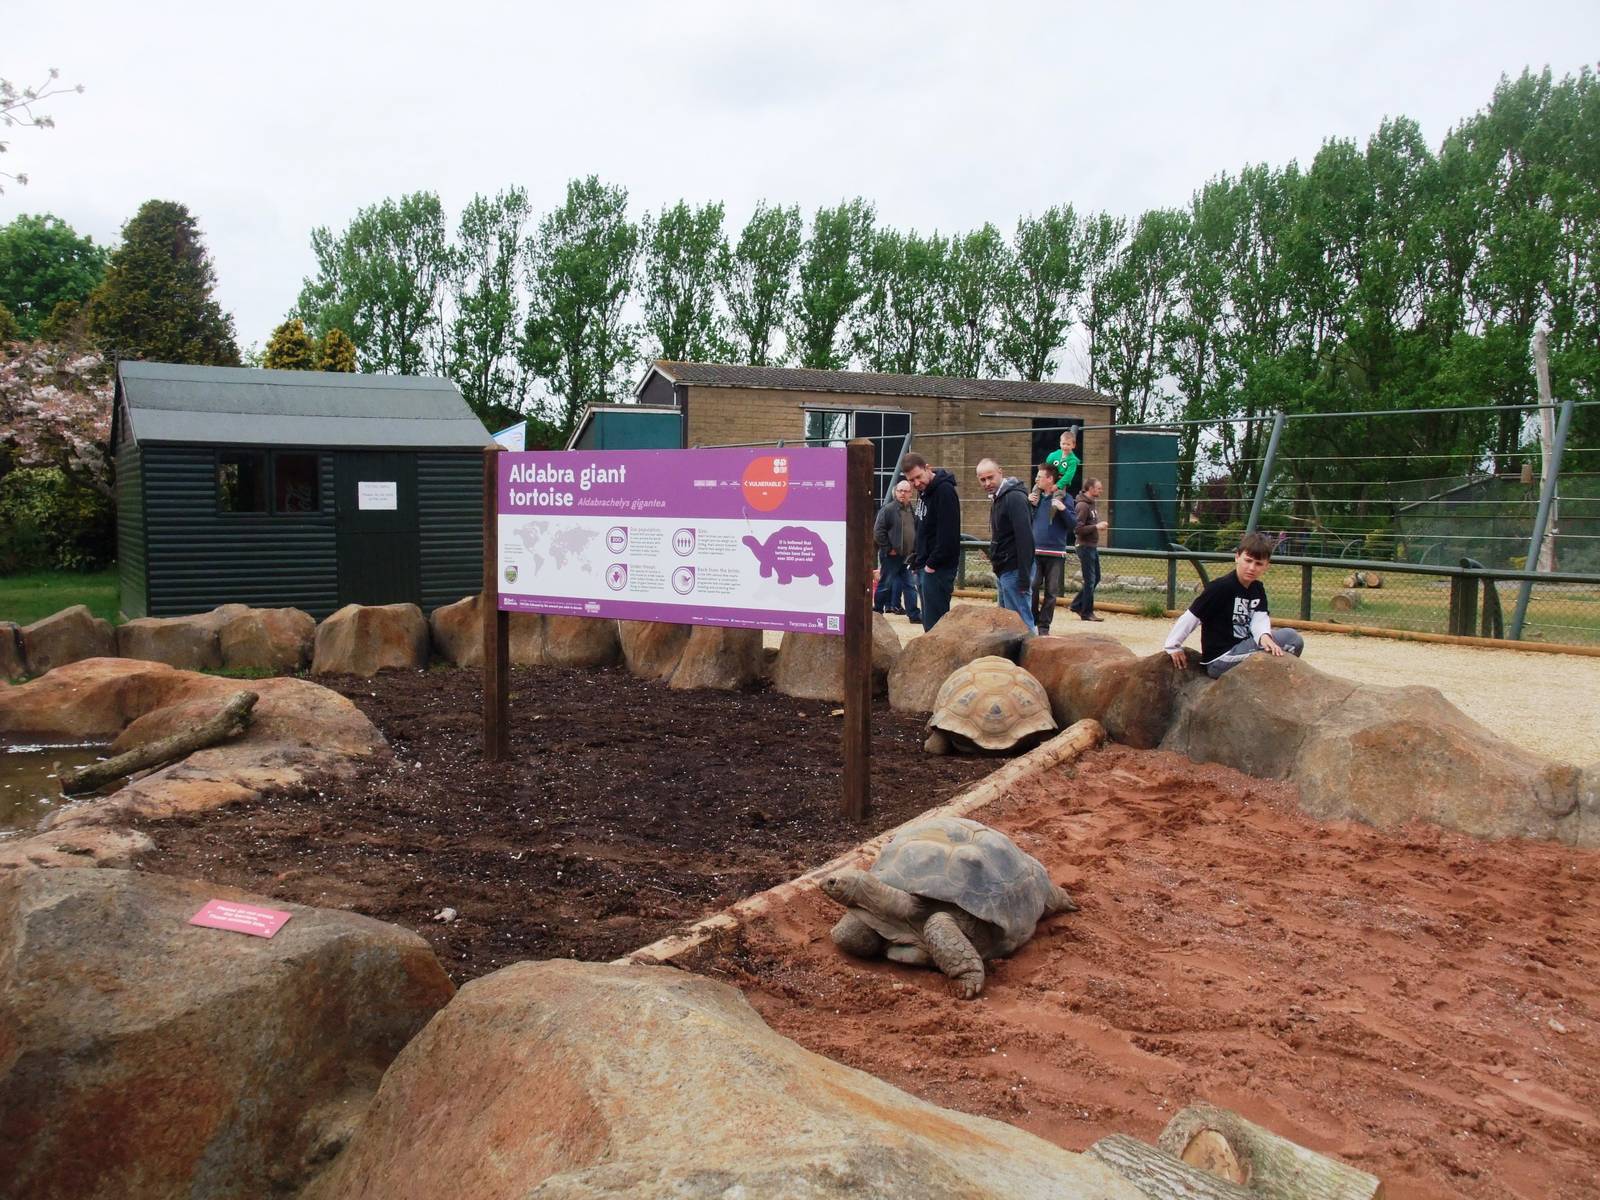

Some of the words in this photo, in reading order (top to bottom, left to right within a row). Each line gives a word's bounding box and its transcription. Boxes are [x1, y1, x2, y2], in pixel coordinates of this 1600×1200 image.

[509, 464, 575, 483] Aldabra
[580, 464, 626, 490] giant
[509, 487, 574, 506] tortoise
[578, 498, 630, 508] Aldabrachelys
[631, 498, 666, 510] gigantea
